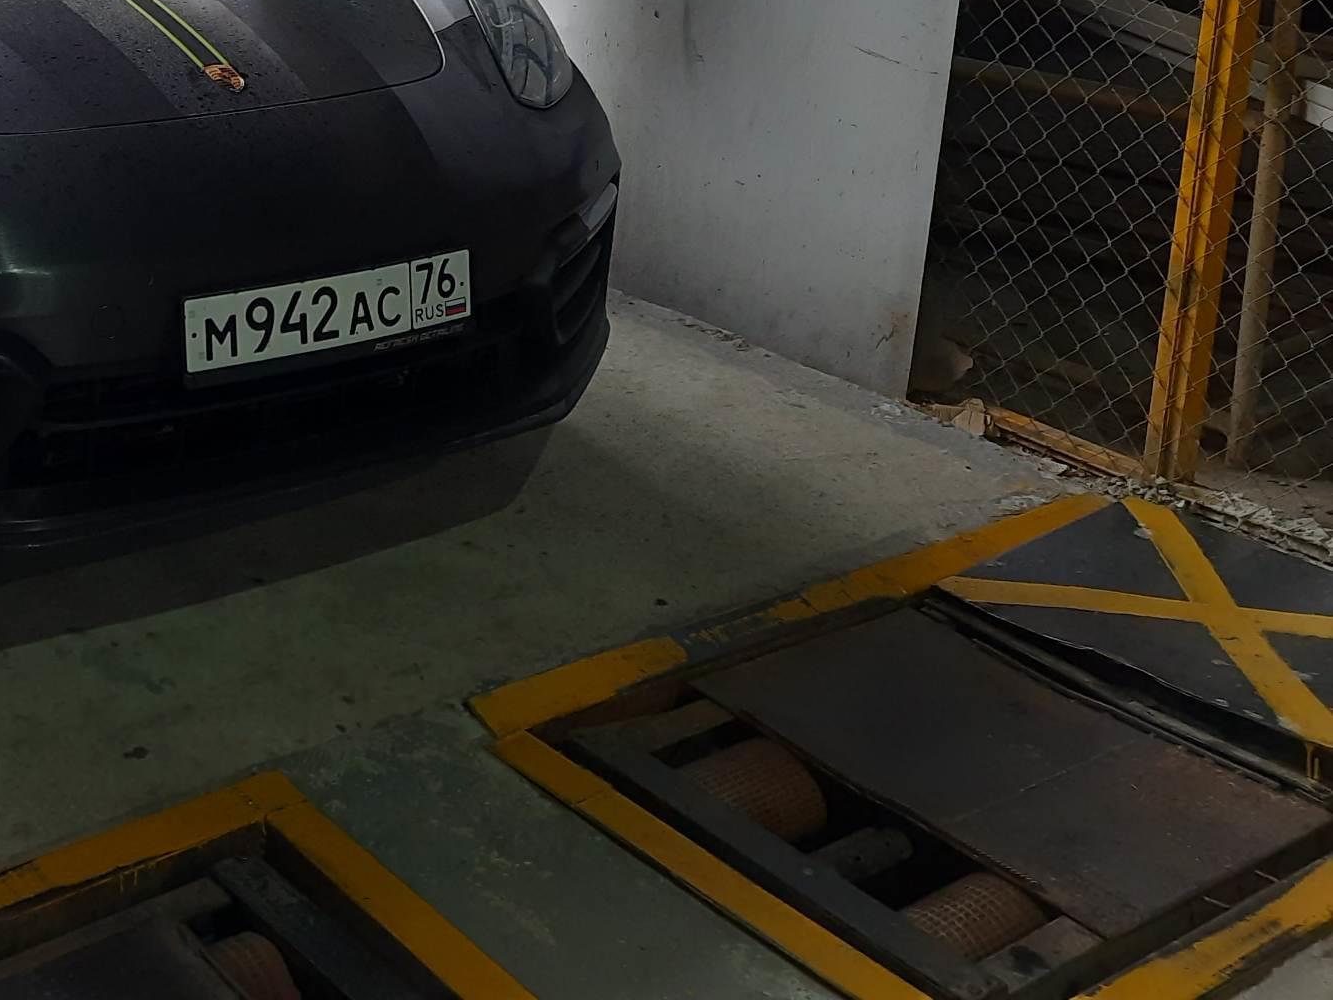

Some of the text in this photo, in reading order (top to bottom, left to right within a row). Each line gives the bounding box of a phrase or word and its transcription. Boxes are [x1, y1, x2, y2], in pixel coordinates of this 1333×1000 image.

[204, 285, 402, 362] М942АС
[415, 258, 457, 305] 76
[414, 302, 445, 323] RUS
